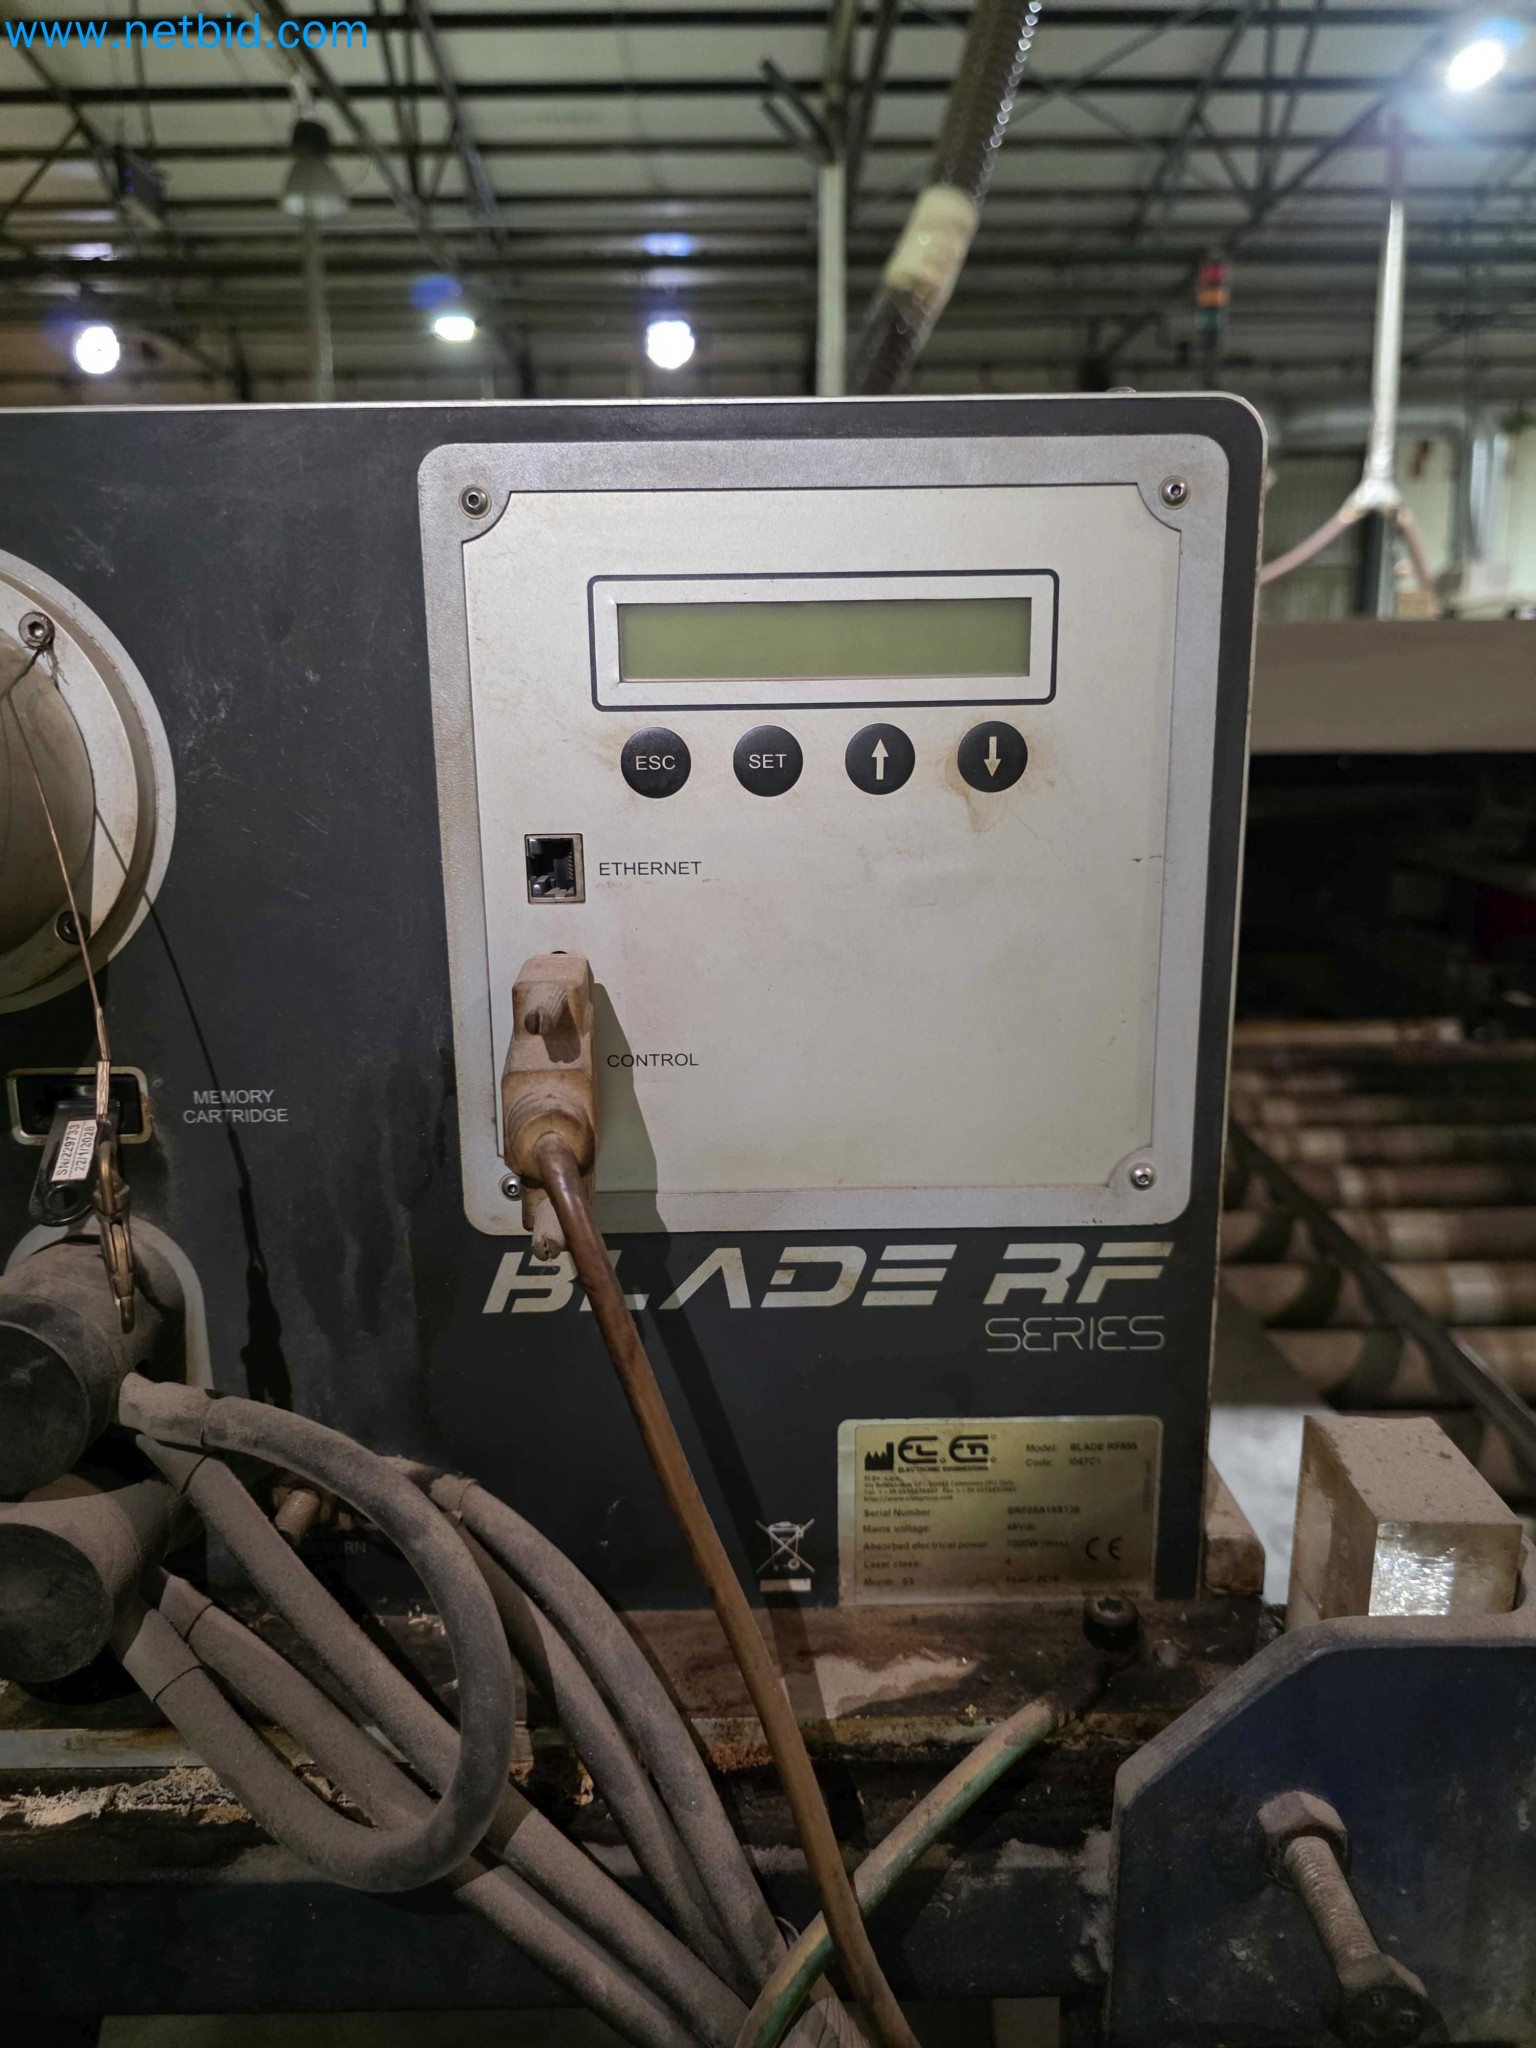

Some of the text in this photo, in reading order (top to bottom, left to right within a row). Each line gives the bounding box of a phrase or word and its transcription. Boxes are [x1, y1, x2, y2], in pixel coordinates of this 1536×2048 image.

[635, 754, 676, 772] ESC
[748, 753, 787, 770] SET
[599, 860, 702, 876] ETHERNET
[607, 1053, 699, 1068] CONTROL
[193, 1089, 274, 1104] MEMORY
[183, 1108, 289, 1123] CARTRIDGE
[983, 1241, 1173, 1305] RF
[985, 1315, 1166, 1352] SERIES
[1026, 1443, 1057, 1453] Model:
[1070, 1442, 1104, 1451] BLADE
[1026, 1457, 1053, 1467] Code:
[864, 1508, 891, 1517] Serial
[863, 1524, 890, 1533] Mains
[863, 1542, 909, 1551] Absorbed
[912, 1541, 956, 1550] electrical
[864, 1560, 890, 1569] Laser
